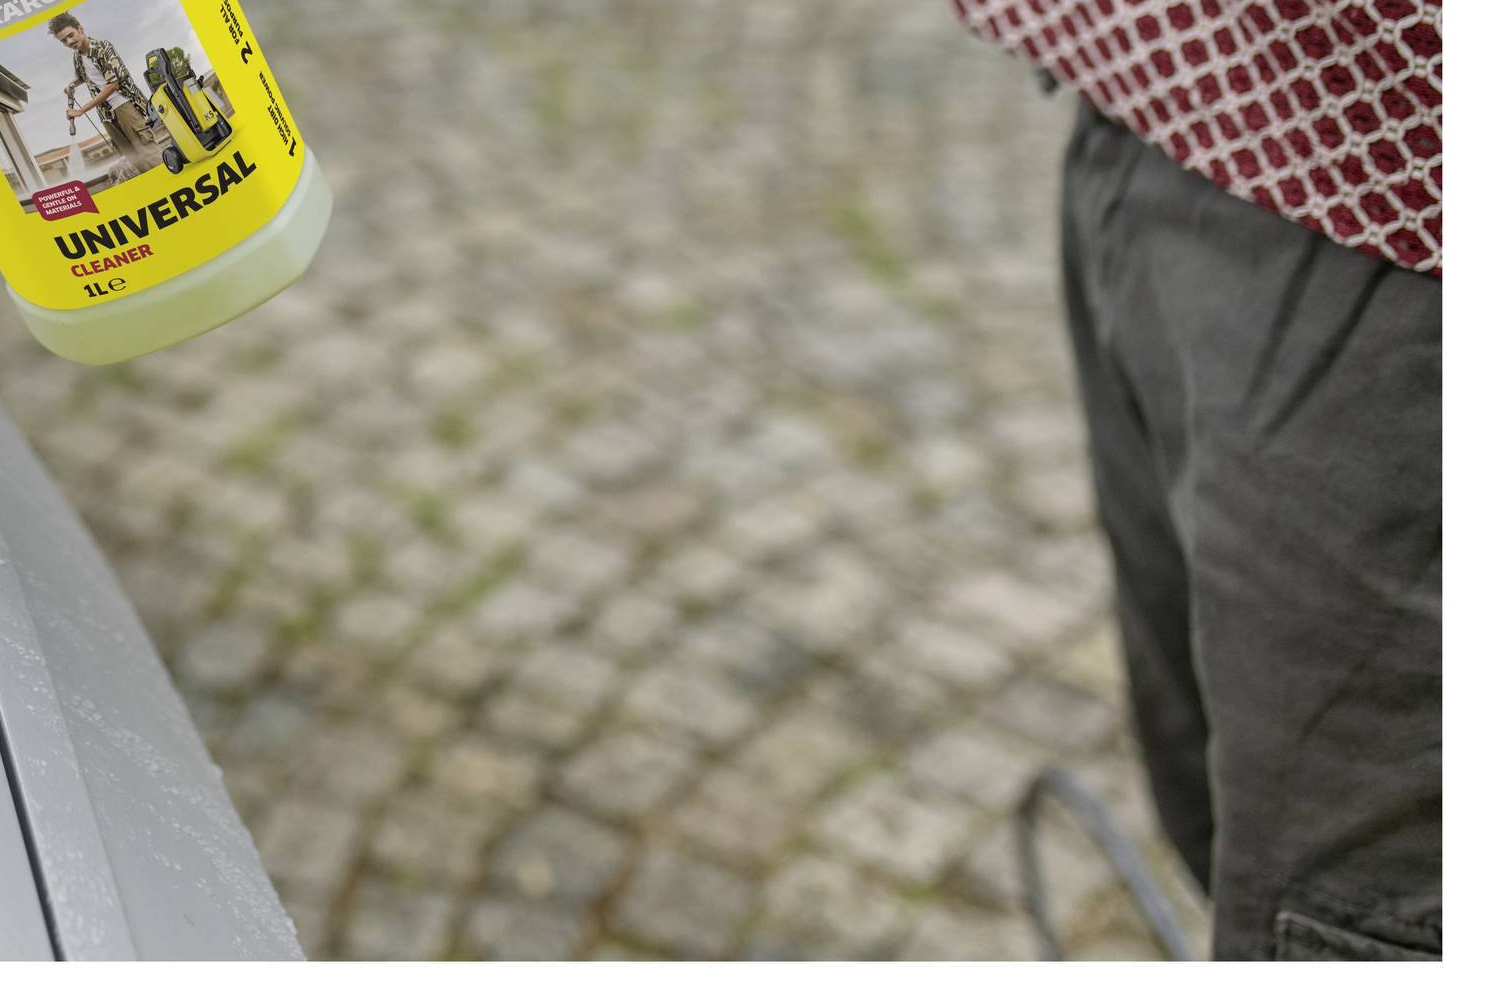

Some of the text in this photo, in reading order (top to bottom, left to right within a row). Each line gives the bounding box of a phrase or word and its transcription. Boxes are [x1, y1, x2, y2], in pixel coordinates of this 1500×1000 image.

[220, 5, 239, 44] FOR ALL
[241, 41, 252, 64] 2
[259, 72, 275, 104] POWER
[268, 105, 288, 145] HIGH DIRT
[289, 137, 296, 156] 1
[39, 188, 74, 202] POWERFUL
[42, 194, 77, 209] GENTLE ON
[45, 201, 82, 215] MATERIALS
[54, 150, 257, 260] UNIVERSAL
[71, 244, 154, 278] CLEANER
